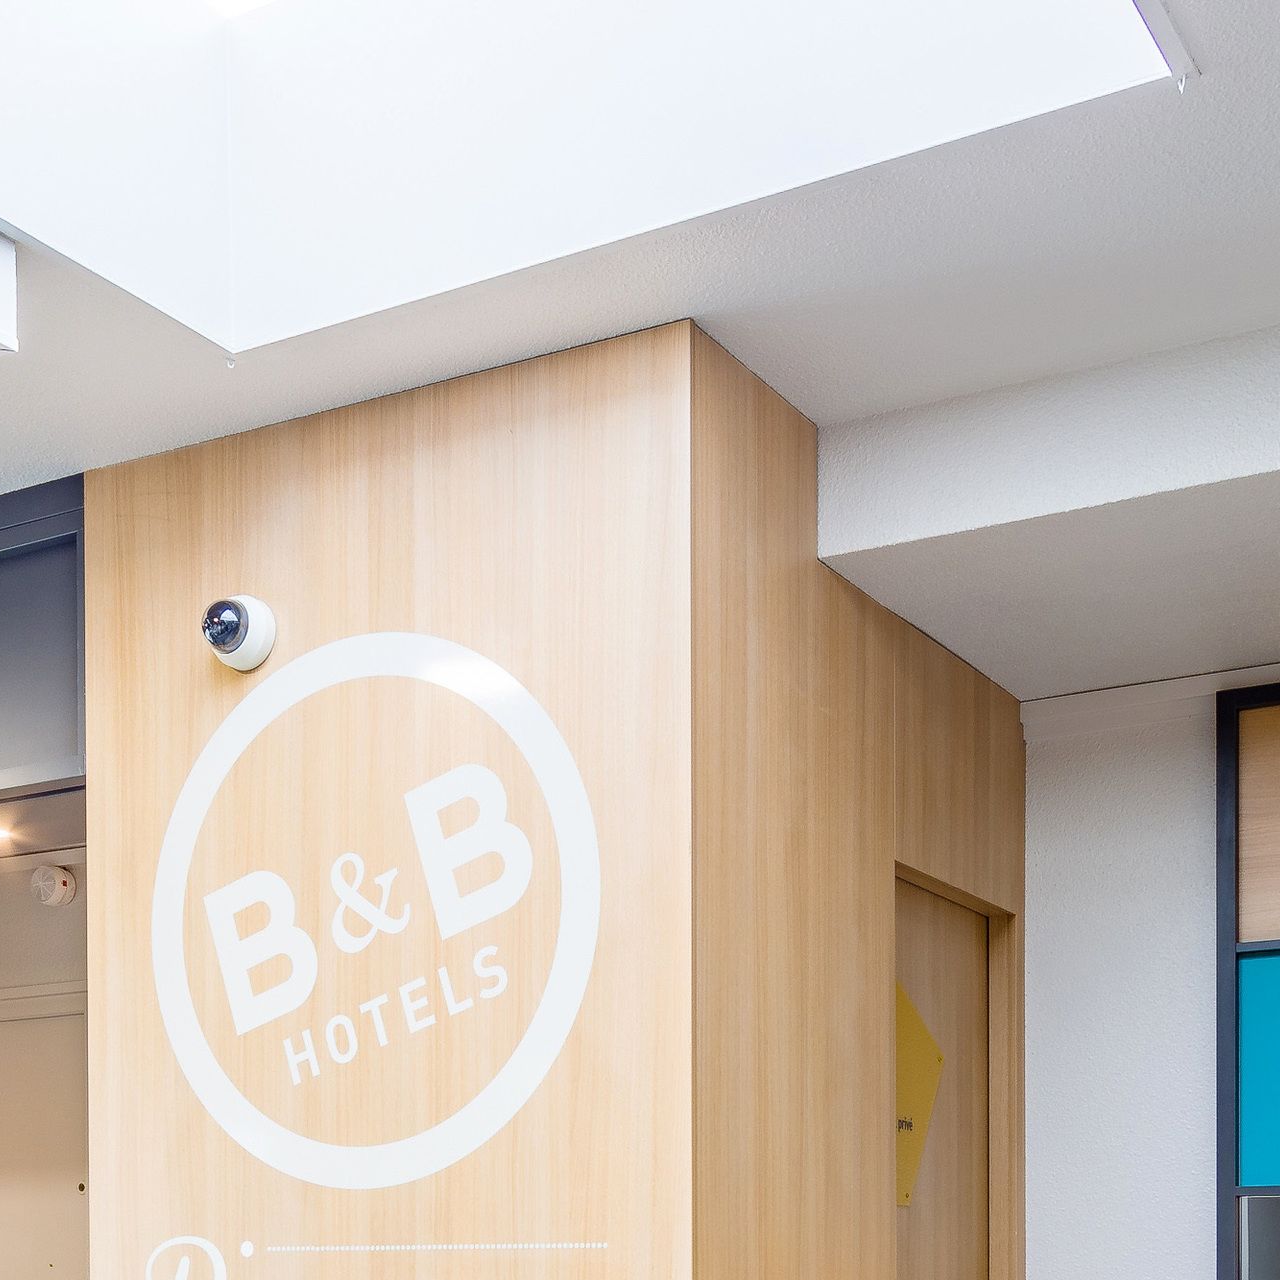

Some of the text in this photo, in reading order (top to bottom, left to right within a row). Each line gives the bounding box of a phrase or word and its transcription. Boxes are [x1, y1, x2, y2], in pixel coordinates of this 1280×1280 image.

[203, 763, 534, 1037] B&B
[283, 945, 508, 1085] HOTELS
[897, 1116, 913, 1132] privé
